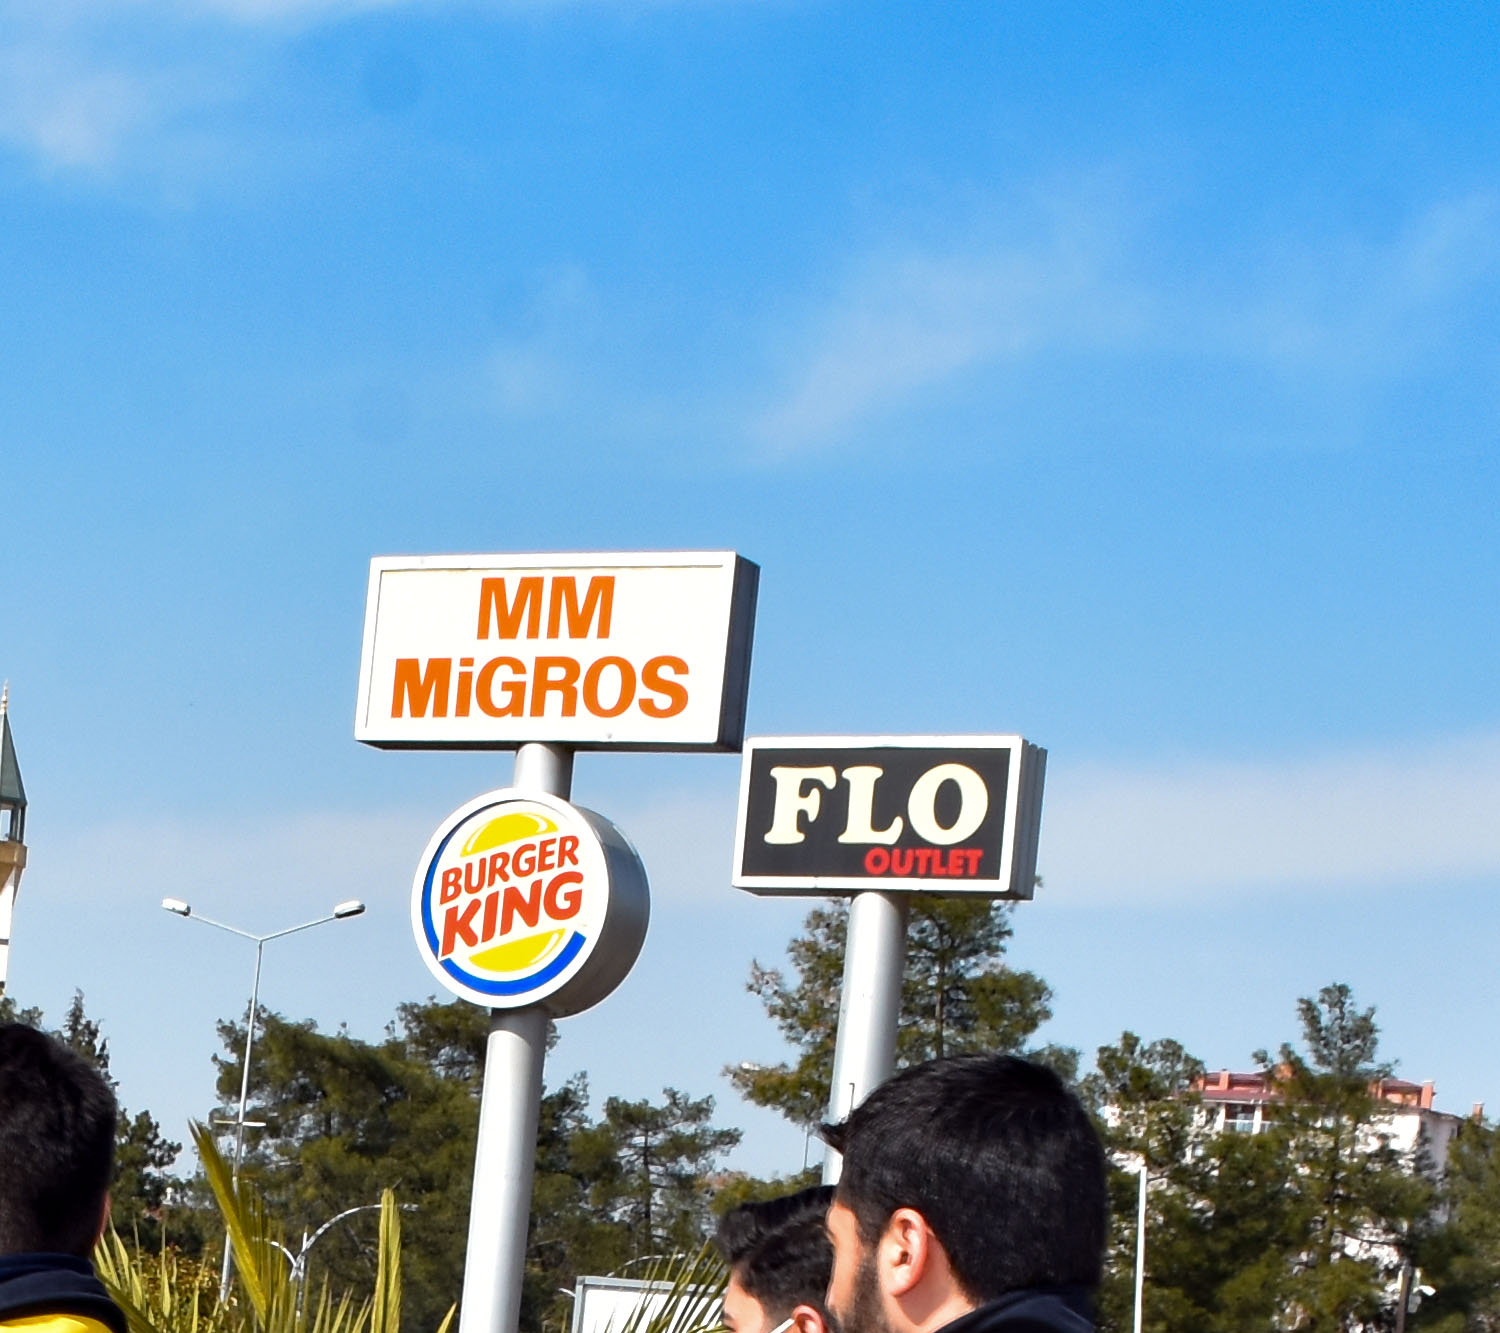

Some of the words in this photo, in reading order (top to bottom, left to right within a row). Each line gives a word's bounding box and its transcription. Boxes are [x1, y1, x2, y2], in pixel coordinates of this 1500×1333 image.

[476, 575, 616, 640] MM
[763, 762, 989, 847] FLO
[438, 834, 581, 906] BURGER
[863, 846, 983, 877] OUTLET
[436, 870, 585, 963] KING
